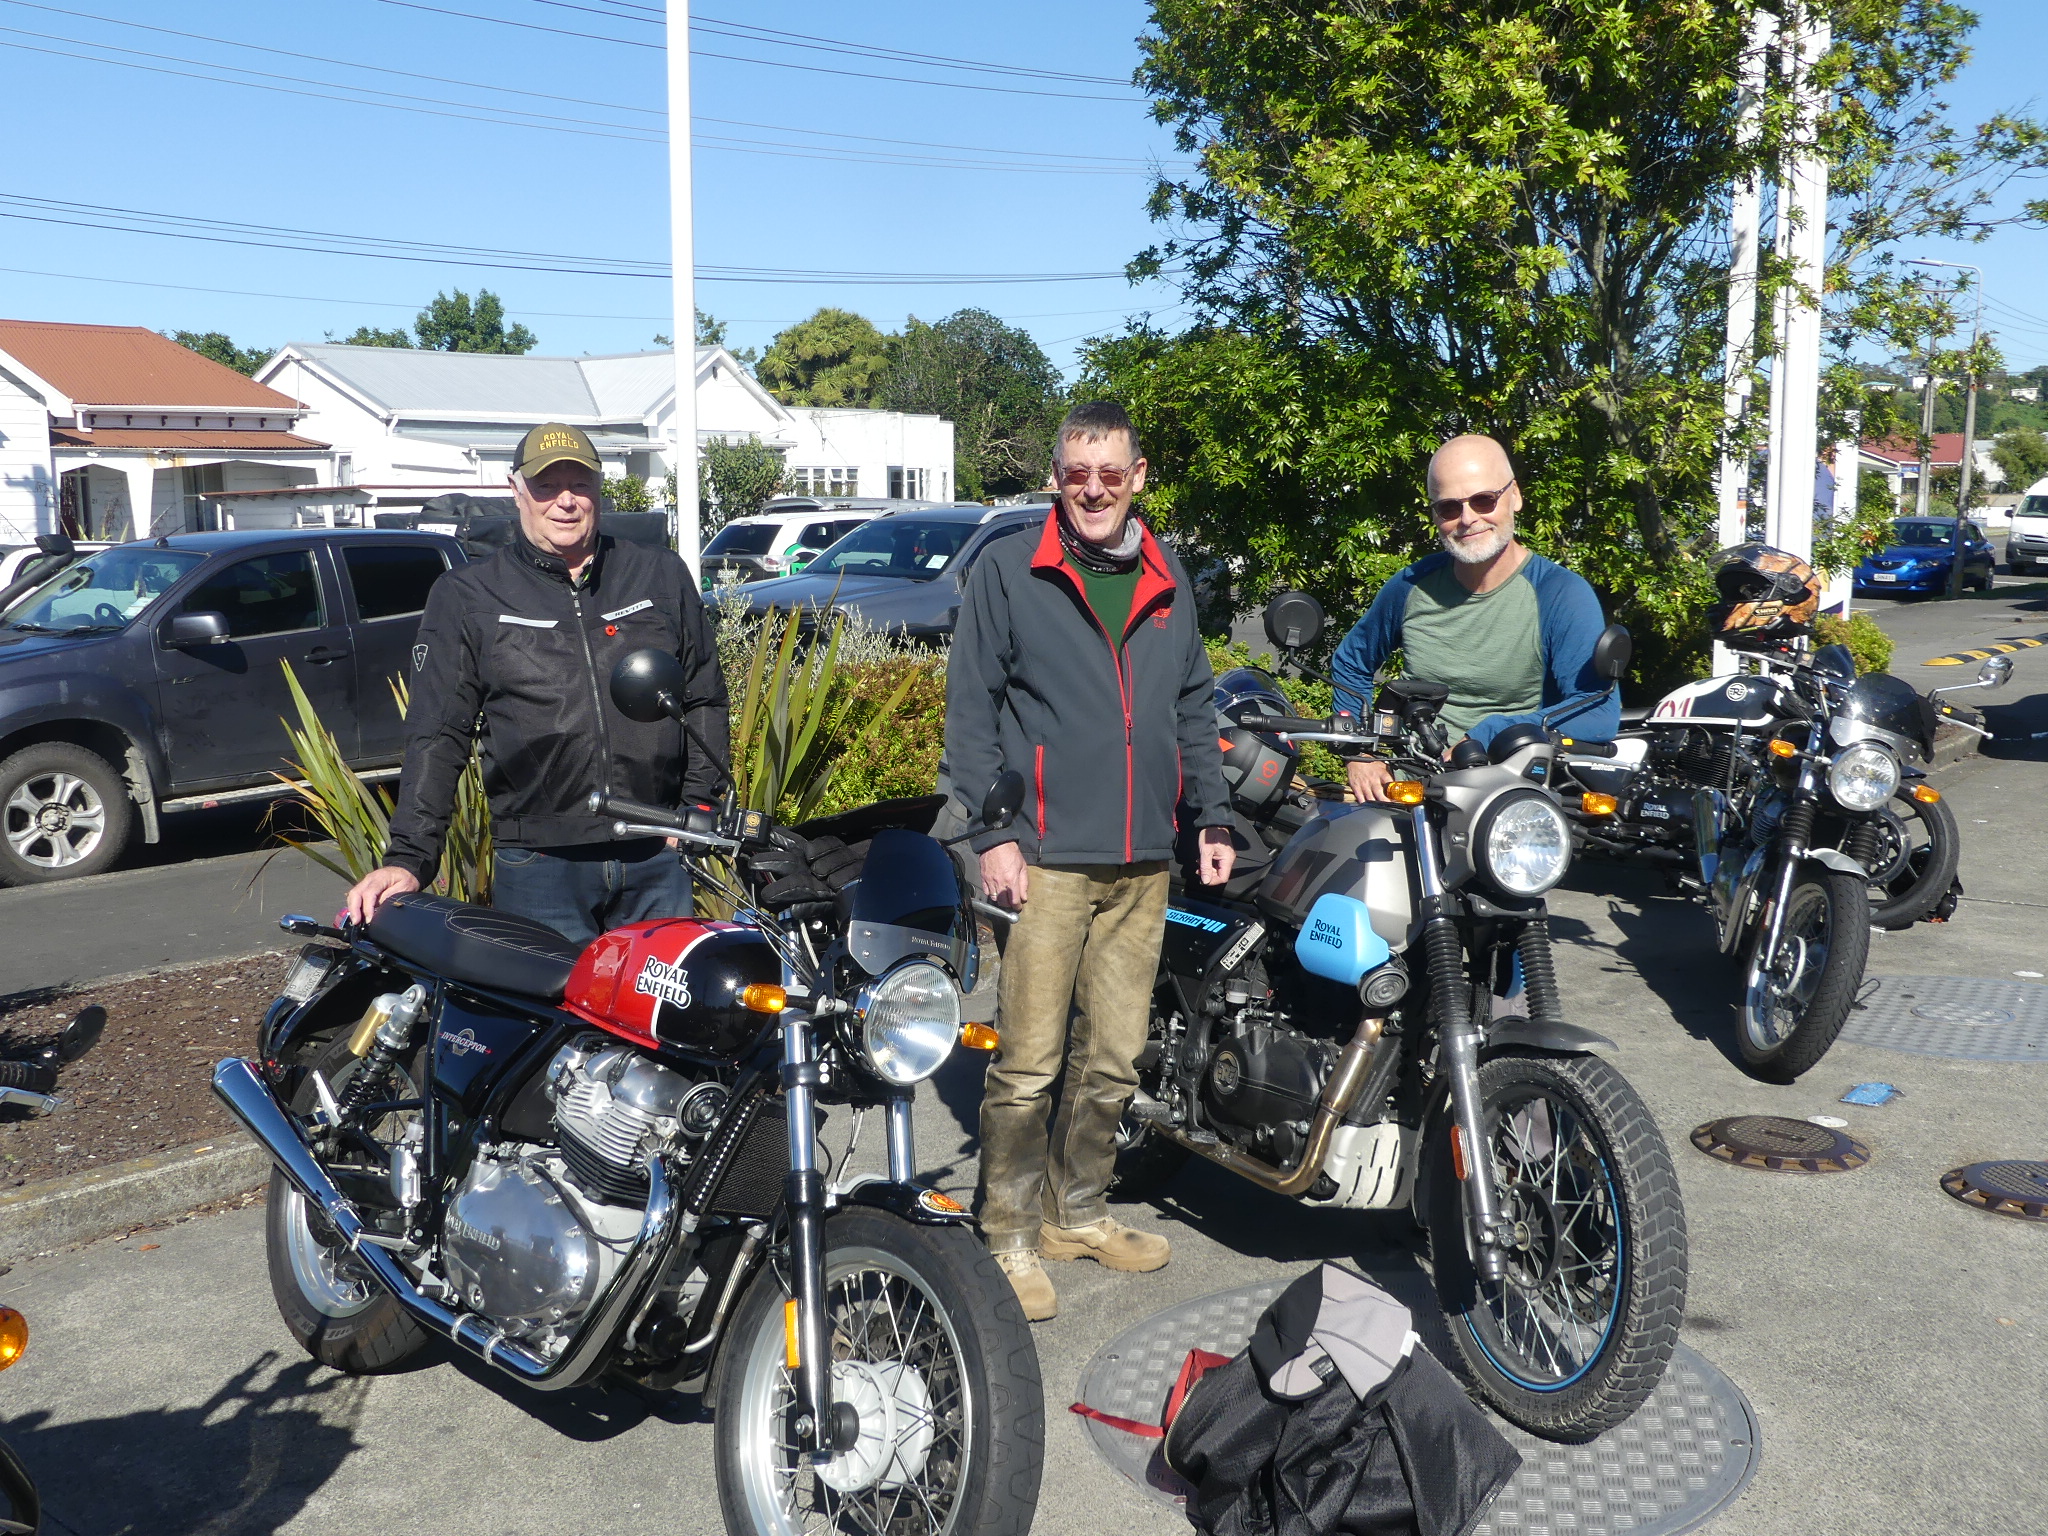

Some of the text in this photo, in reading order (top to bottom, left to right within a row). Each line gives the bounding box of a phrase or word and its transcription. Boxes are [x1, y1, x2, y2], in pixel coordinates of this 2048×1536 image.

[540, 440, 579, 451] ENFIELD
[543, 432, 574, 441] ROYAL
[1640, 809, 1670, 820] ENFIELD
[1643, 802, 1667, 811] ROYAL
[1314, 918, 1341, 937] ROYAL
[1309, 930, 1343, 949] ENFIELD
[644, 956, 688, 987] ROYAL
[635, 974, 691, 1009] ENFIELD
[441, 1031, 487, 1053] INTERCEPTOR
